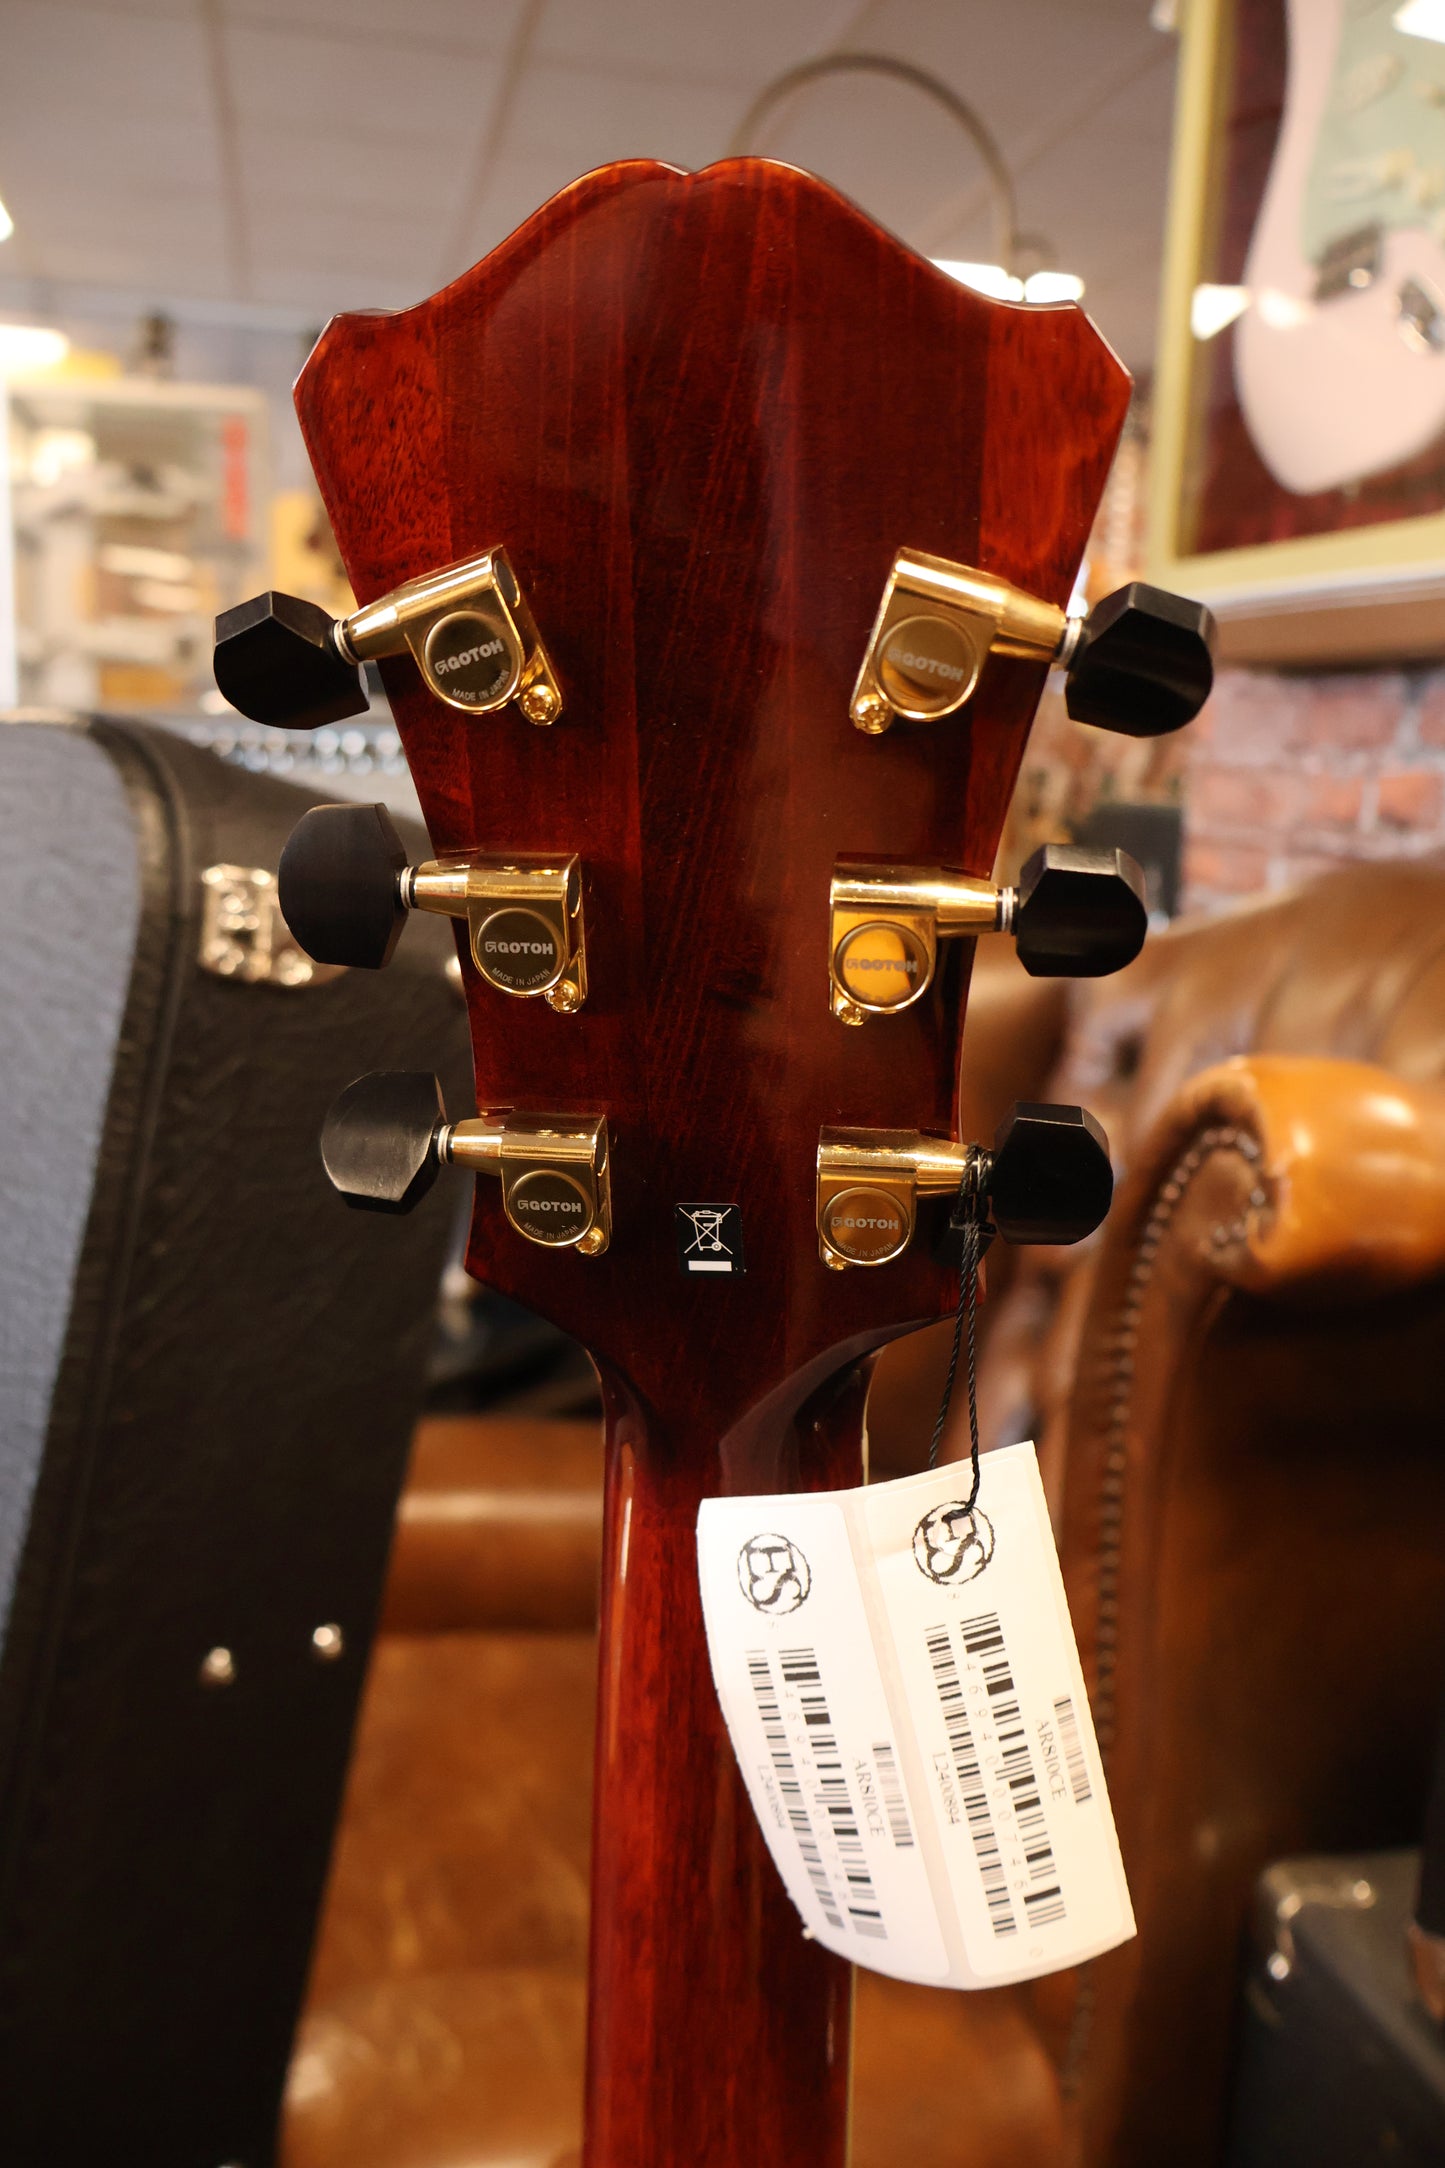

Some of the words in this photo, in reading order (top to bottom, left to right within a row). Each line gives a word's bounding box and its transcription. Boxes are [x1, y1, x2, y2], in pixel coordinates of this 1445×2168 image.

[451, 688, 476, 702] MADE
[478, 689, 490, 700] IN
[490, 669, 510, 696] JAPAN
[491, 967, 514, 984] MADE
[515, 978, 525, 986] IN
[527, 968, 552, 986] JAPAN
[522, 1222, 544, 1238] MADE
[546, 1232, 555, 1240] IN
[556, 1224, 580, 1239] JAPAN
[858, 1248, 869, 1257] IN
[871, 1242, 895, 1257] JAPAN
